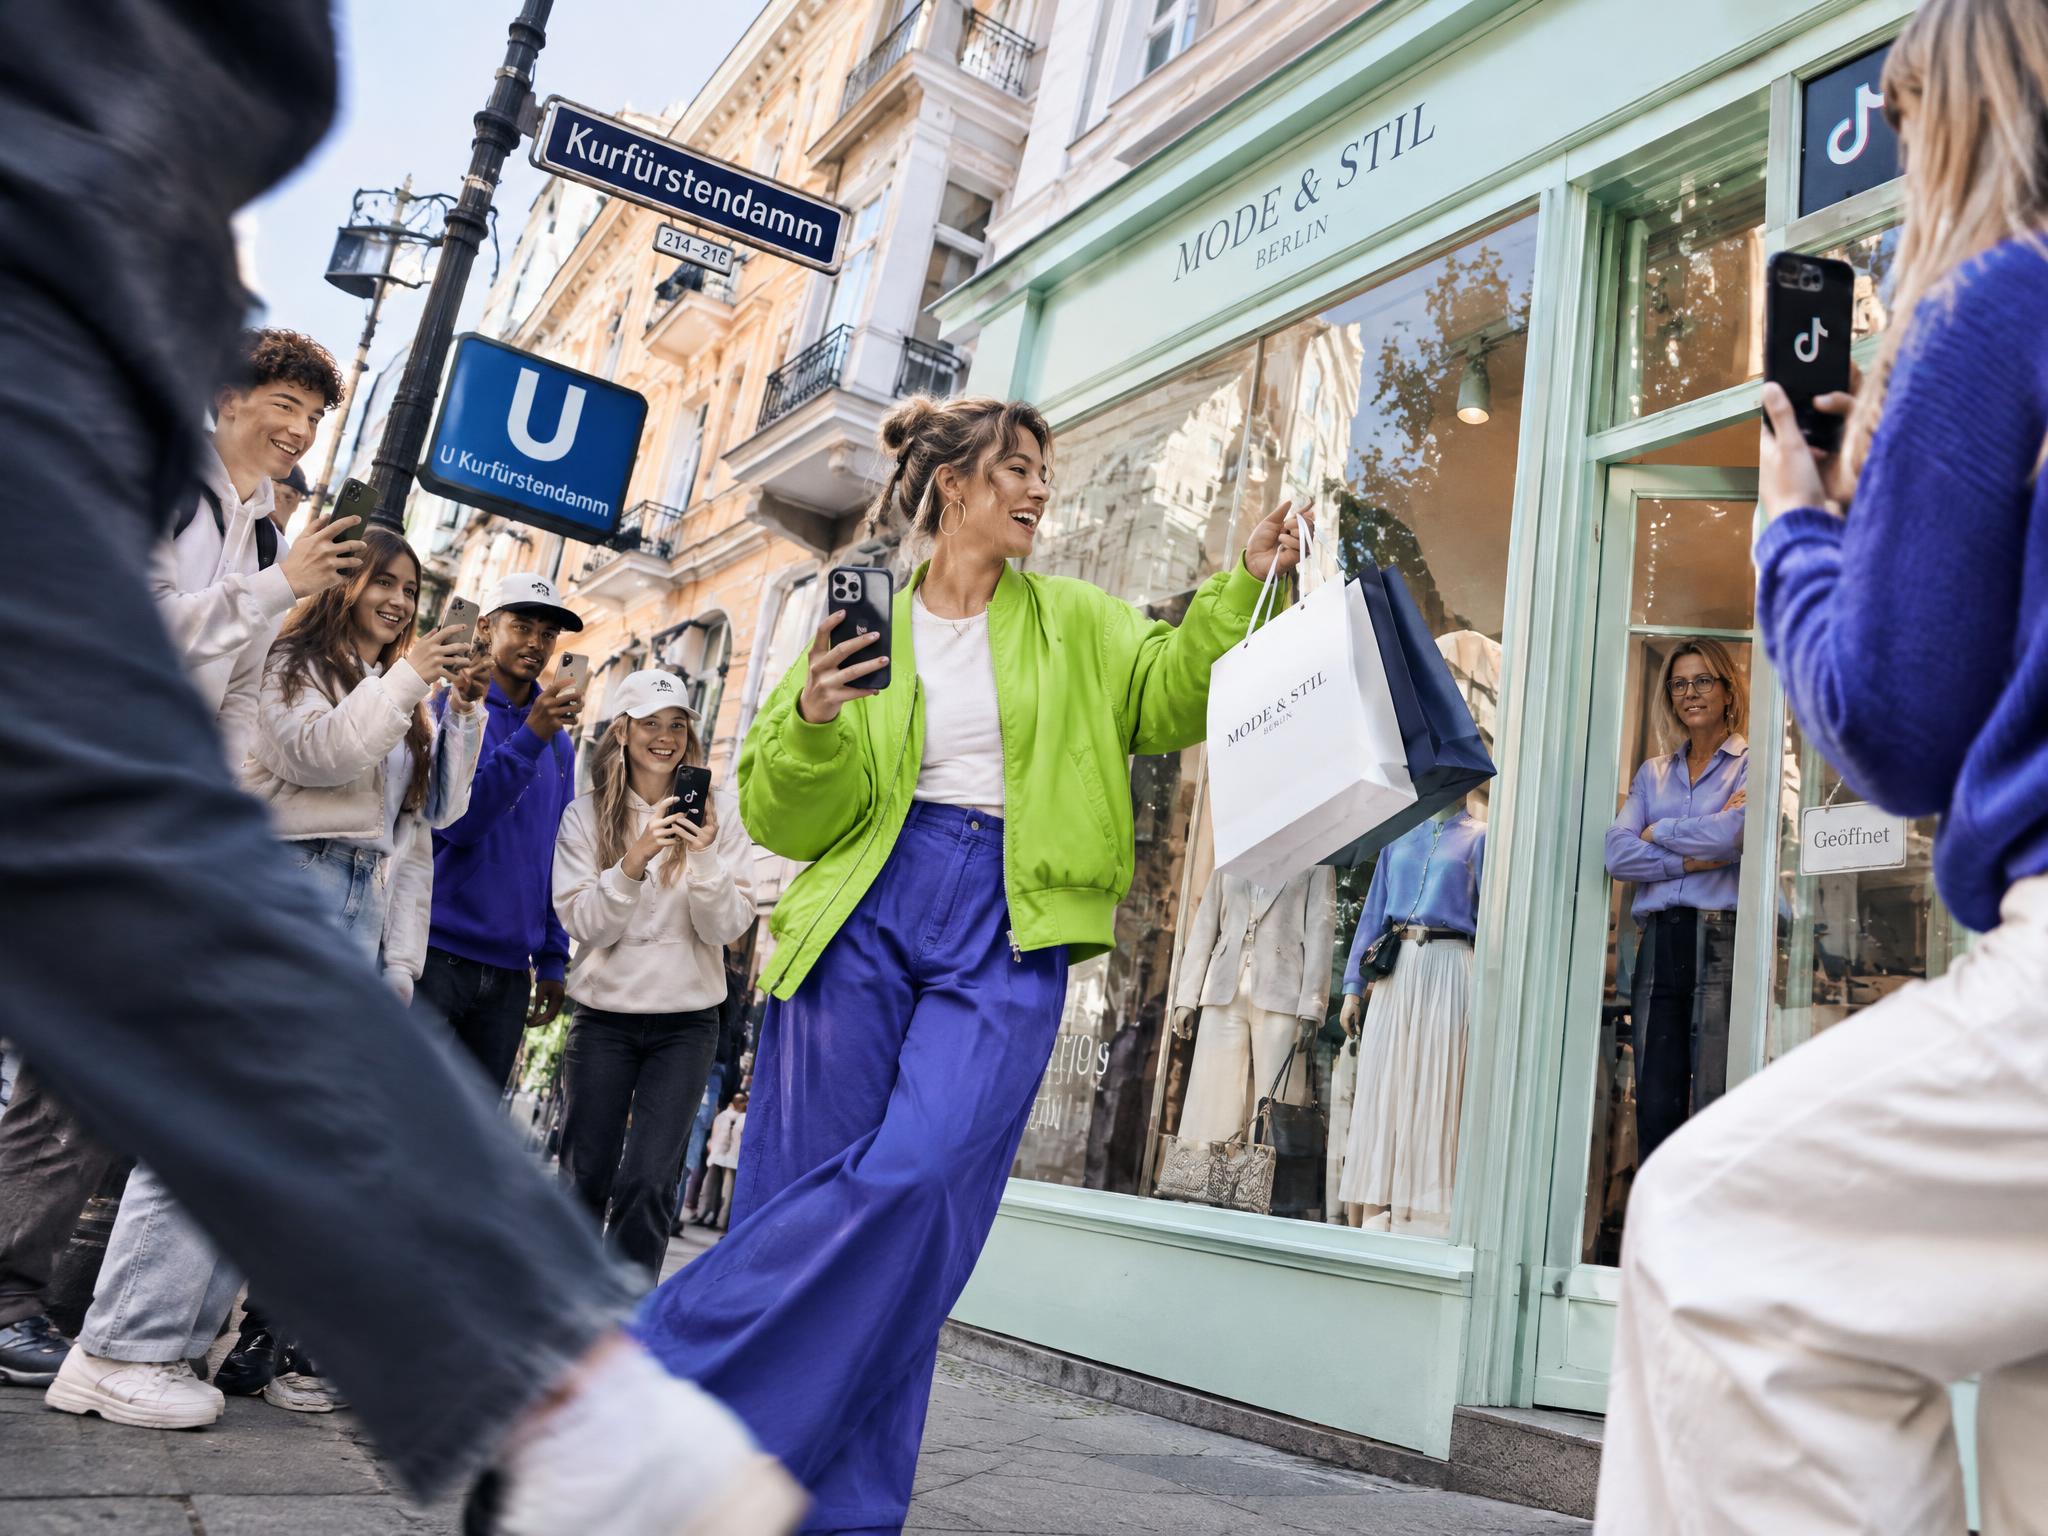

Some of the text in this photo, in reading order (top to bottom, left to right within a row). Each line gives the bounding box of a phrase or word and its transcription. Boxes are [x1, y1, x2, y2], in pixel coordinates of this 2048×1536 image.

[565, 122, 823, 247] Kurfürstendamm
[1172, 102, 1436, 284] MODE & STIL
[1255, 214, 1329, 271] BERLIN
[507, 367, 587, 462] U
[440, 445, 610, 517] U Kurfürstendamm
[1227, 671, 1327, 747] MODE & STIL
[1814, 826, 1890, 849] Geöffnet
